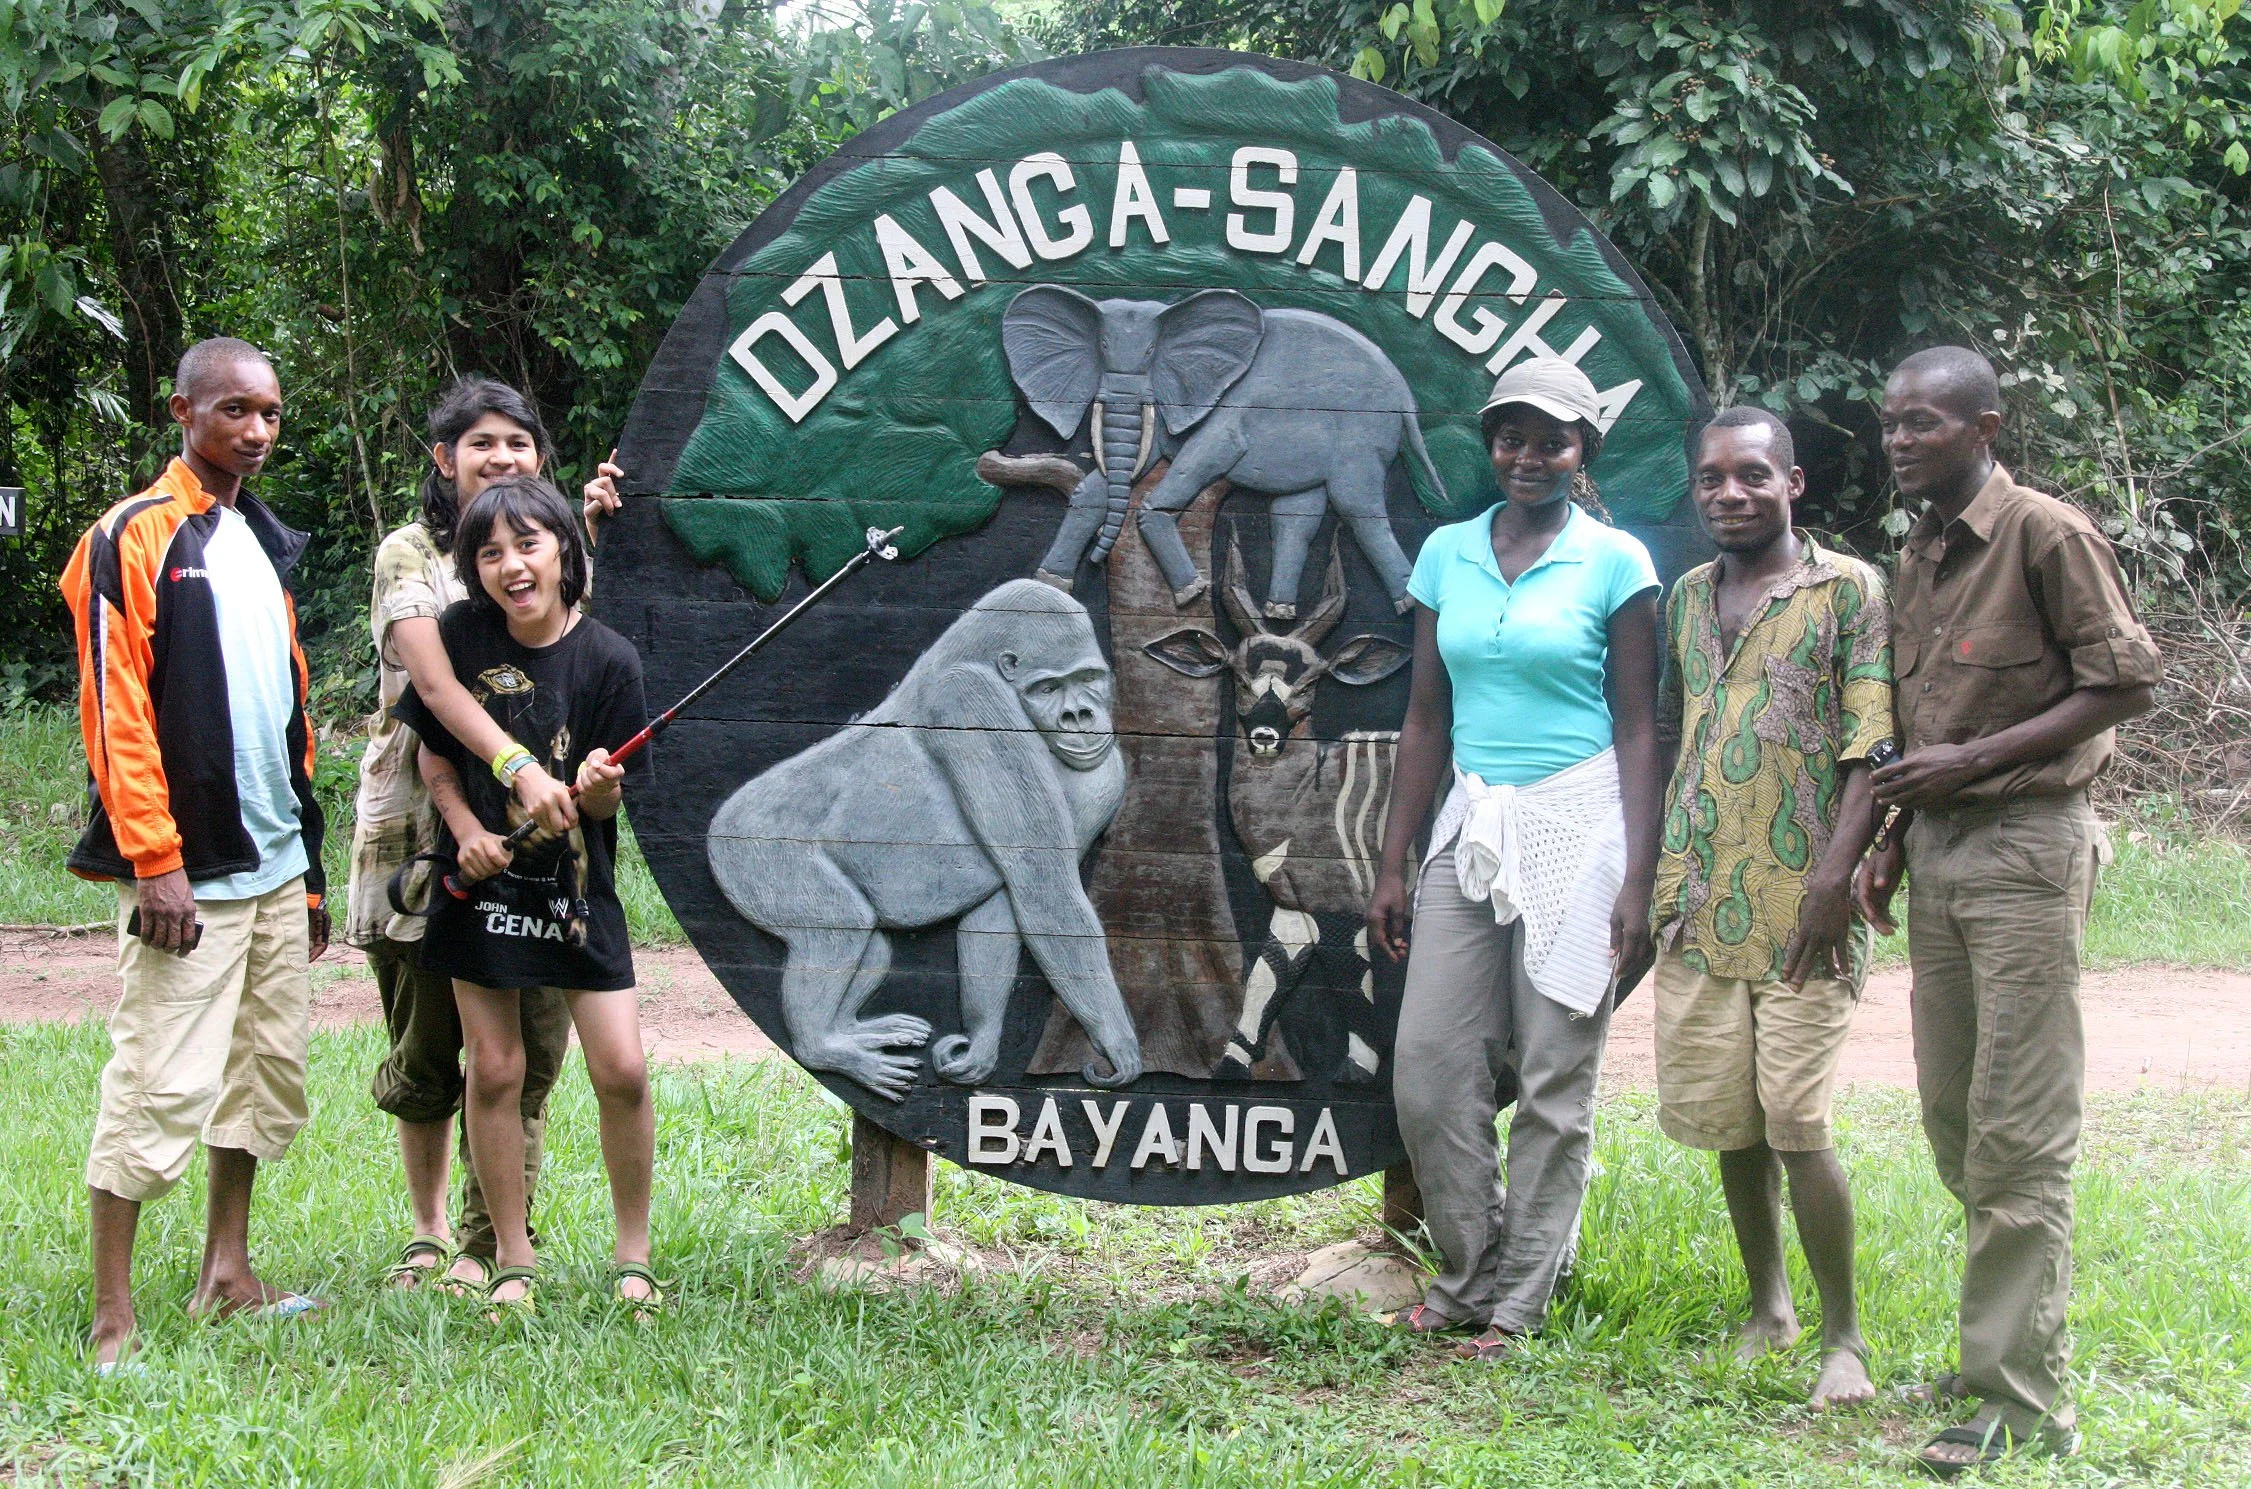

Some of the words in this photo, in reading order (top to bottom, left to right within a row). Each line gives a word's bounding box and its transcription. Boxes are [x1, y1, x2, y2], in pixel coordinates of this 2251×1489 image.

[474, 900, 508, 914] JOHN
[486, 912, 564, 943] CENA
[967, 1096, 1348, 1176] BAYANGA
